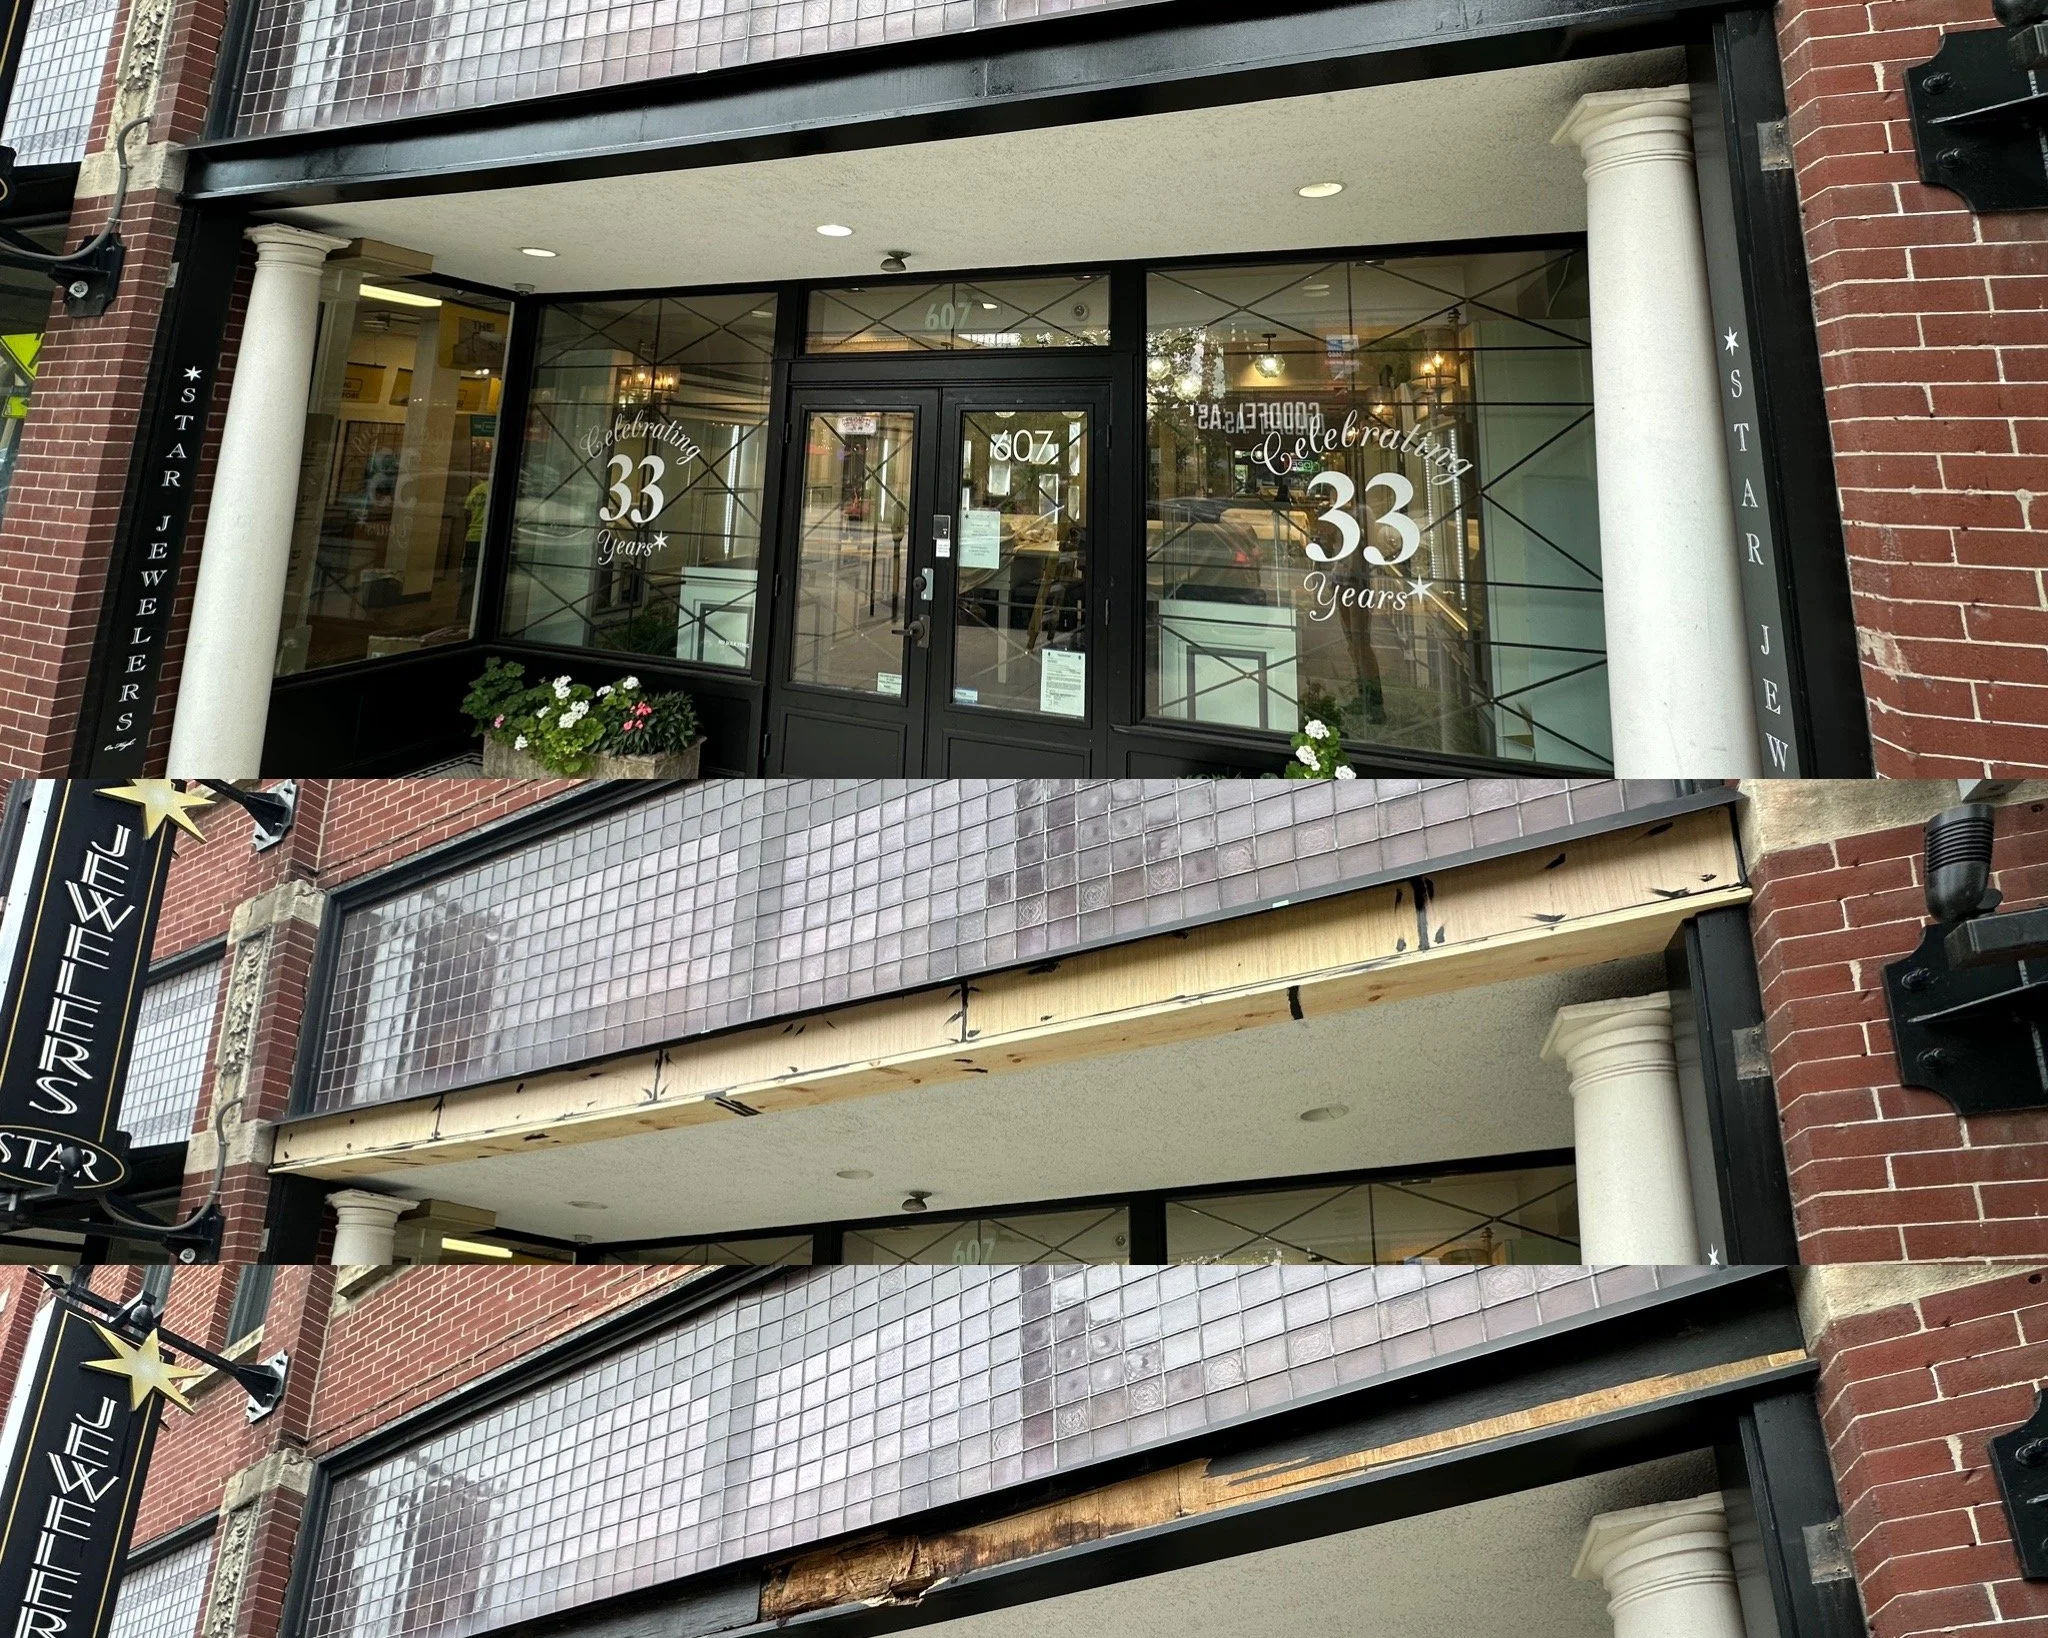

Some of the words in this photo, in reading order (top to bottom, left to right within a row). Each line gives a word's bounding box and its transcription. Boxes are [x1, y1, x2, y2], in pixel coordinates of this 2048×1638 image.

[924, 301, 973, 332] 607
[161, 387, 197, 488] STAR
[580, 408, 701, 465] Celebrating
[993, 428, 1054, 462] 607
[1250, 408, 1474, 486] Celebrating
[1730, 369, 1764, 566] STAR
[599, 453, 665, 524] 33
[1304, 470, 1422, 566] 33
[597, 528, 655, 566] Years
[116, 514, 172, 732] JEWELERS
[1303, 571, 1408, 622] Years
[29, 824, 135, 1115] JEWELERS
[951, 1237, 997, 1265] 607
